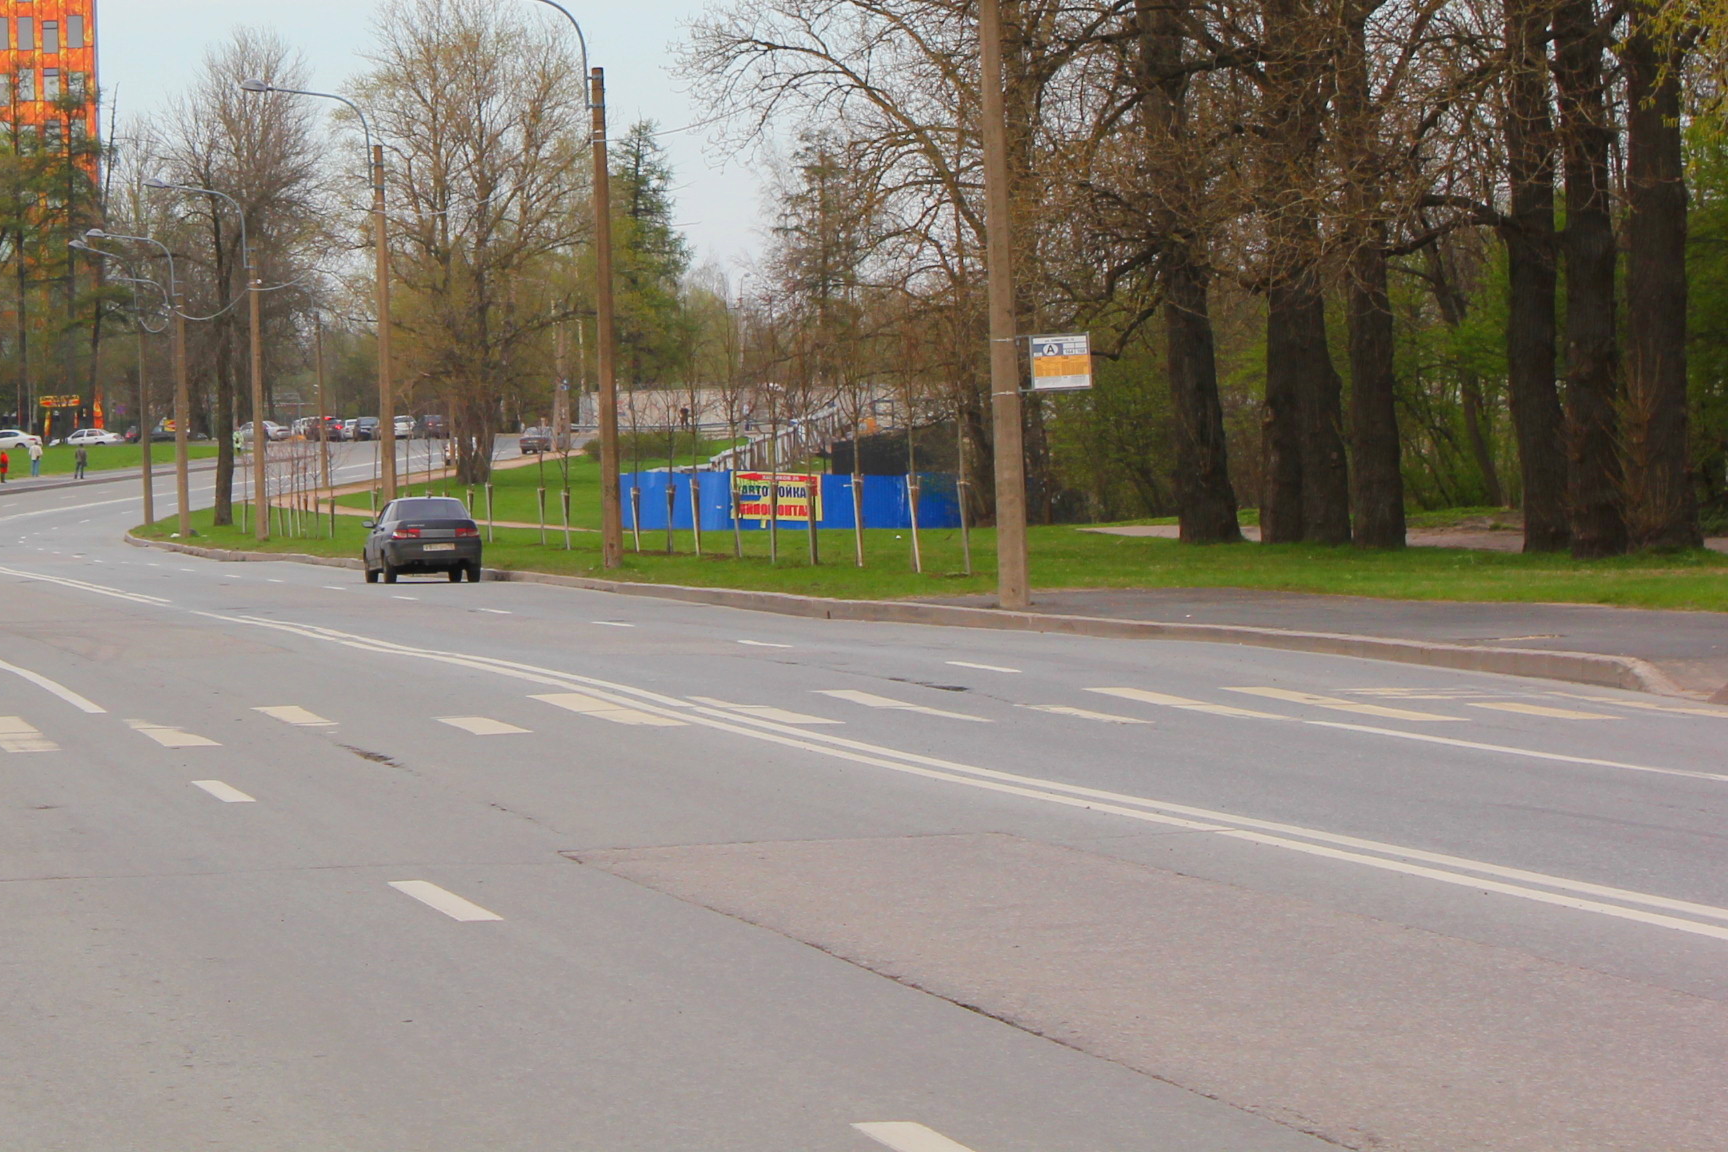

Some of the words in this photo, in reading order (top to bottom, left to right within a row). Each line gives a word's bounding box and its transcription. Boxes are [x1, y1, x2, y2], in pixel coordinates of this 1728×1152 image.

[1046, 344, 1055, 354] А
[741, 484, 806, 498] АВТООЙКА
[738, 503, 809, 516] ИНООНТА
